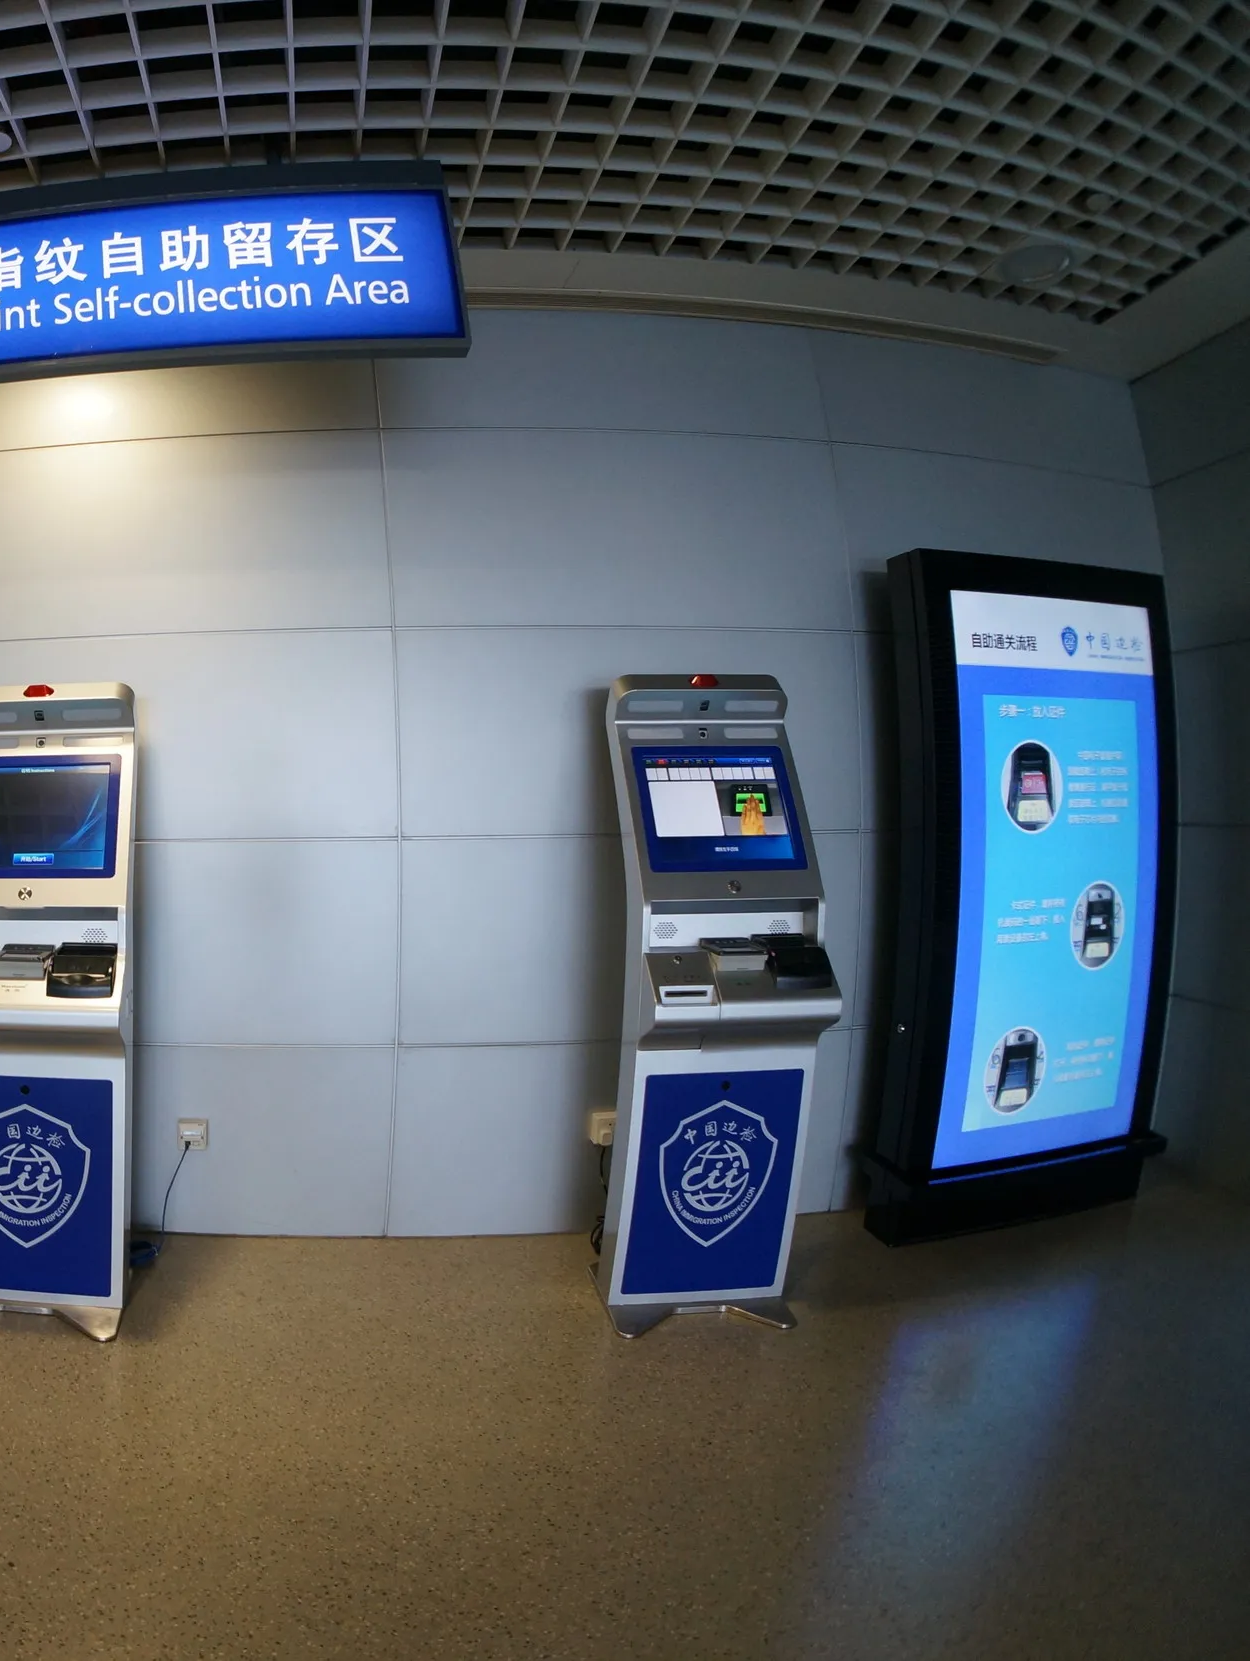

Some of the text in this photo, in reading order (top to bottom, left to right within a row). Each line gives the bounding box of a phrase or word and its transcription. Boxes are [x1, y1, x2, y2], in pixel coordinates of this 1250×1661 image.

[53, 273, 312, 326] Self-collection
[325, 273, 411, 307] Area
[971, 631, 1039, 652] 自助通关流程
[40, 1193, 72, 1225] INSPECTION
[671, 1190, 683, 1212] CHINA
[722, 1186, 757, 1222] INSPECTION
